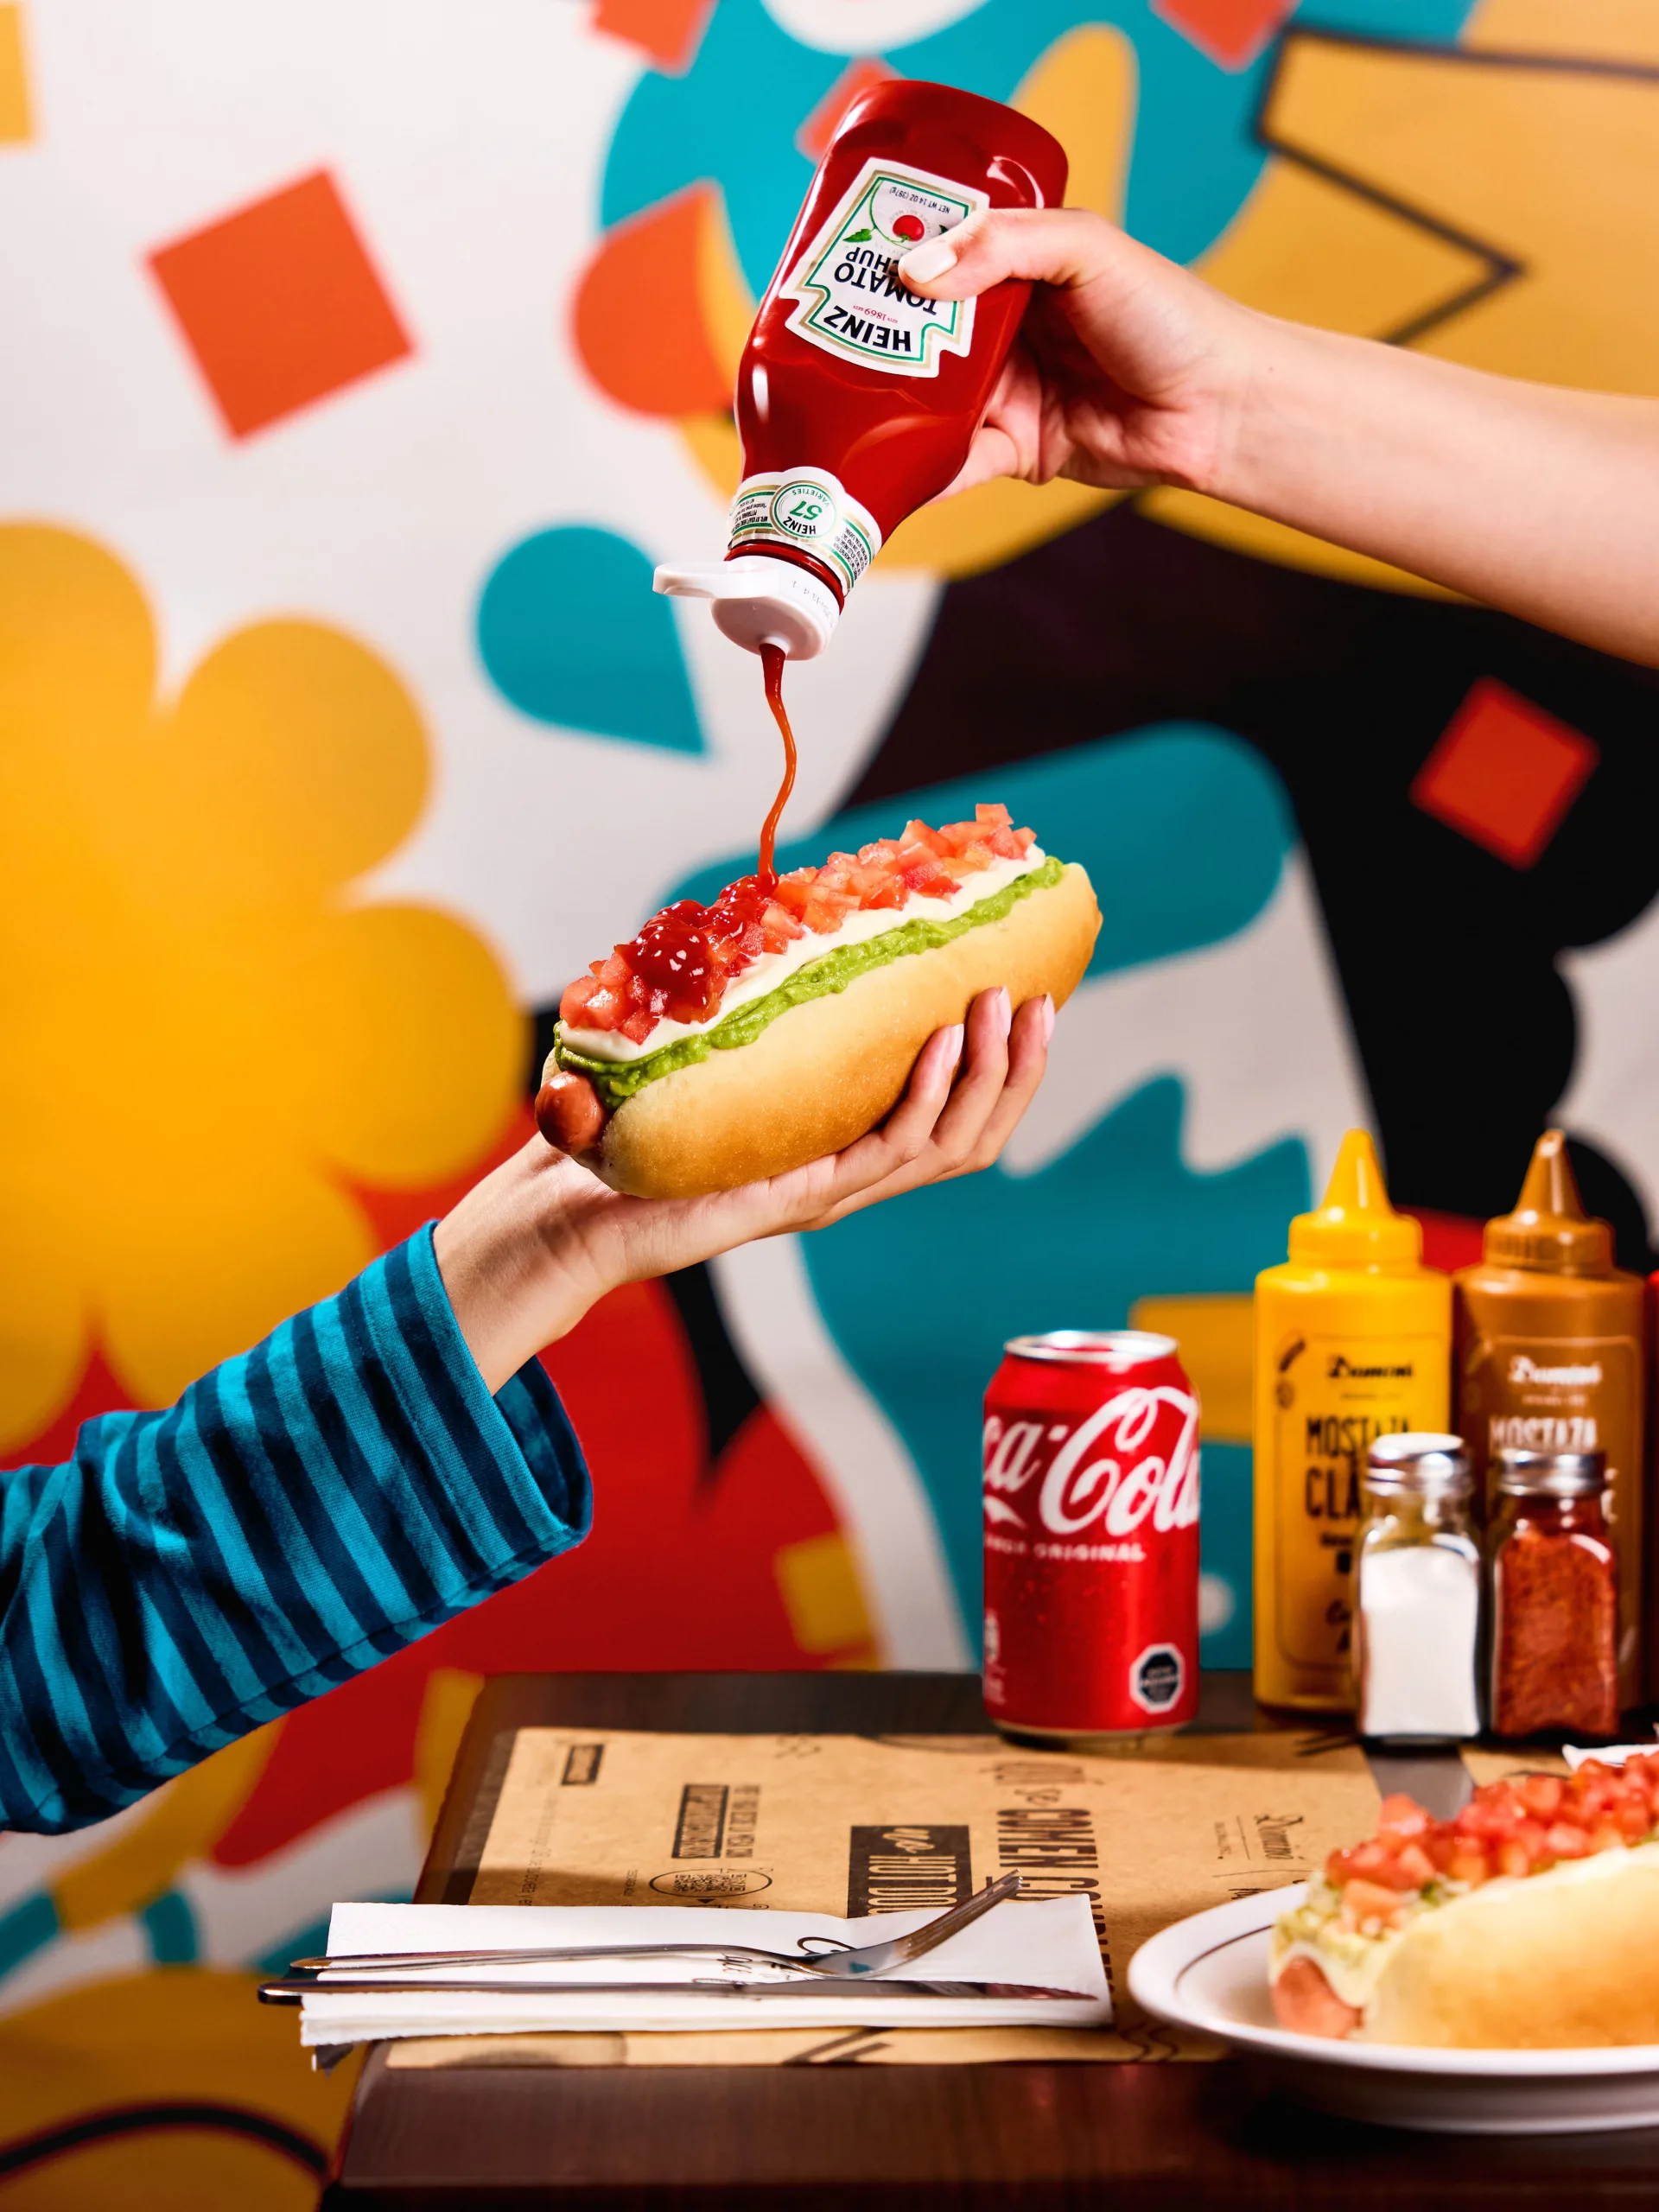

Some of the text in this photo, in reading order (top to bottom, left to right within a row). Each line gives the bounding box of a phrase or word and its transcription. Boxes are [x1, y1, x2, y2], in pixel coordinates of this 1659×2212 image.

[908, 194, 918, 202] OZ
[927, 200, 938, 209] WT
[937, 202, 950, 214] NET
[845, 246, 899, 277] CHUP
[834, 263, 938, 315] TOMATO
[864, 307, 887, 321] 1869
[823, 305, 912, 353] HEINZ
[792, 488, 830, 508] VARIETIES
[790, 500, 823, 521] 57
[783, 516, 817, 535] HEINZ
[983, 1385, 1201, 1536] ca-Cola
[1033, 1543, 1147, 1562] ORIGINAL
[882, 1827, 936, 1853] no
[997, 1808, 1099, 1868] COMEN
[868, 1855, 957, 1882] HOT
